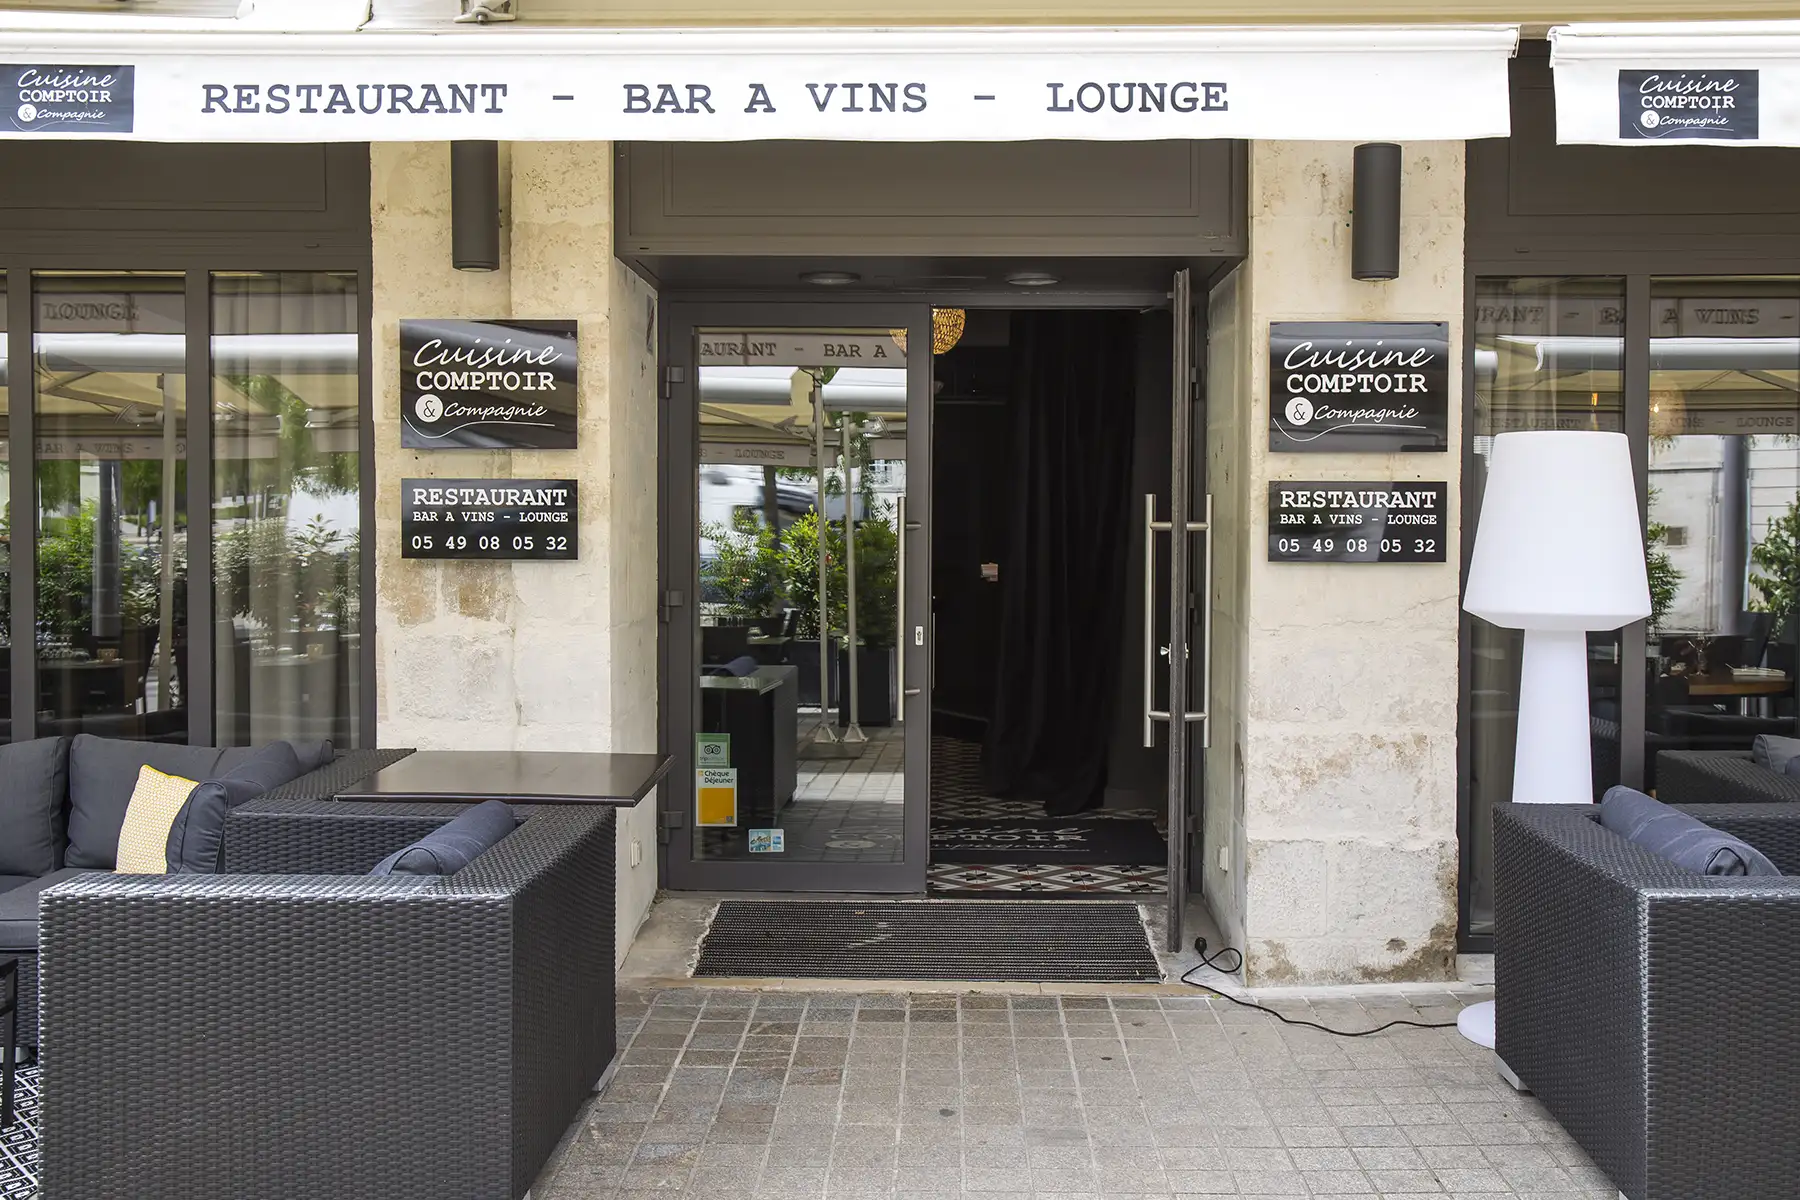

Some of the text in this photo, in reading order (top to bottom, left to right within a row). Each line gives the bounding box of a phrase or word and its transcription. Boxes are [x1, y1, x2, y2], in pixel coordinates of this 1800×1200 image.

[18, 69, 116, 88] Cuisine
[1640, 74, 1740, 94] Cuisine
[19, 90, 112, 103] COMPTOIR
[201, 84, 508, 114] RESTAURANT
[623, 84, 716, 114] BAR
[744, 84, 776, 114] A
[806, 84, 927, 113] VINS
[1046, 82, 1229, 113] LOUNGE
[1641, 96, 1736, 109] COMPTOIR
[36, 109, 106, 121] Compagnie
[1660, 115, 1729, 127] Compagnie
[413, 338, 562, 369] Cuisine
[824, 344, 862, 358] BAR
[873, 345, 887, 358] A
[1284, 340, 1434, 371] Cuisine
[416, 371, 556, 391] COMPTOIR
[1286, 374, 1428, 393] COMPTOIR
[444, 402, 548, 420] Compagnie
[1314, 404, 1419, 423] Compagnie
[1736, 417, 1795, 427] LOUNGE
[412, 488, 567, 506] RESTAURANT
[1280, 491, 1436, 508] RESTAURANT
[413, 512, 438, 522] BAR
[445, 512, 455, 522] A
[463, 512, 495, 522] VINS
[519, 512, 569, 522] LOUNGE
[1280, 514, 1306, 525] BAR
[1313, 514, 1322, 524] A
[1330, 514, 1362, 525] VINS
[1388, 514, 1437, 525] LOUNGE
[412, 536, 567, 550] 05 49 08 05 32
[1278, 538, 1435, 553] 05 49 08 05 32
[704, 770, 730, 778] Chèque
